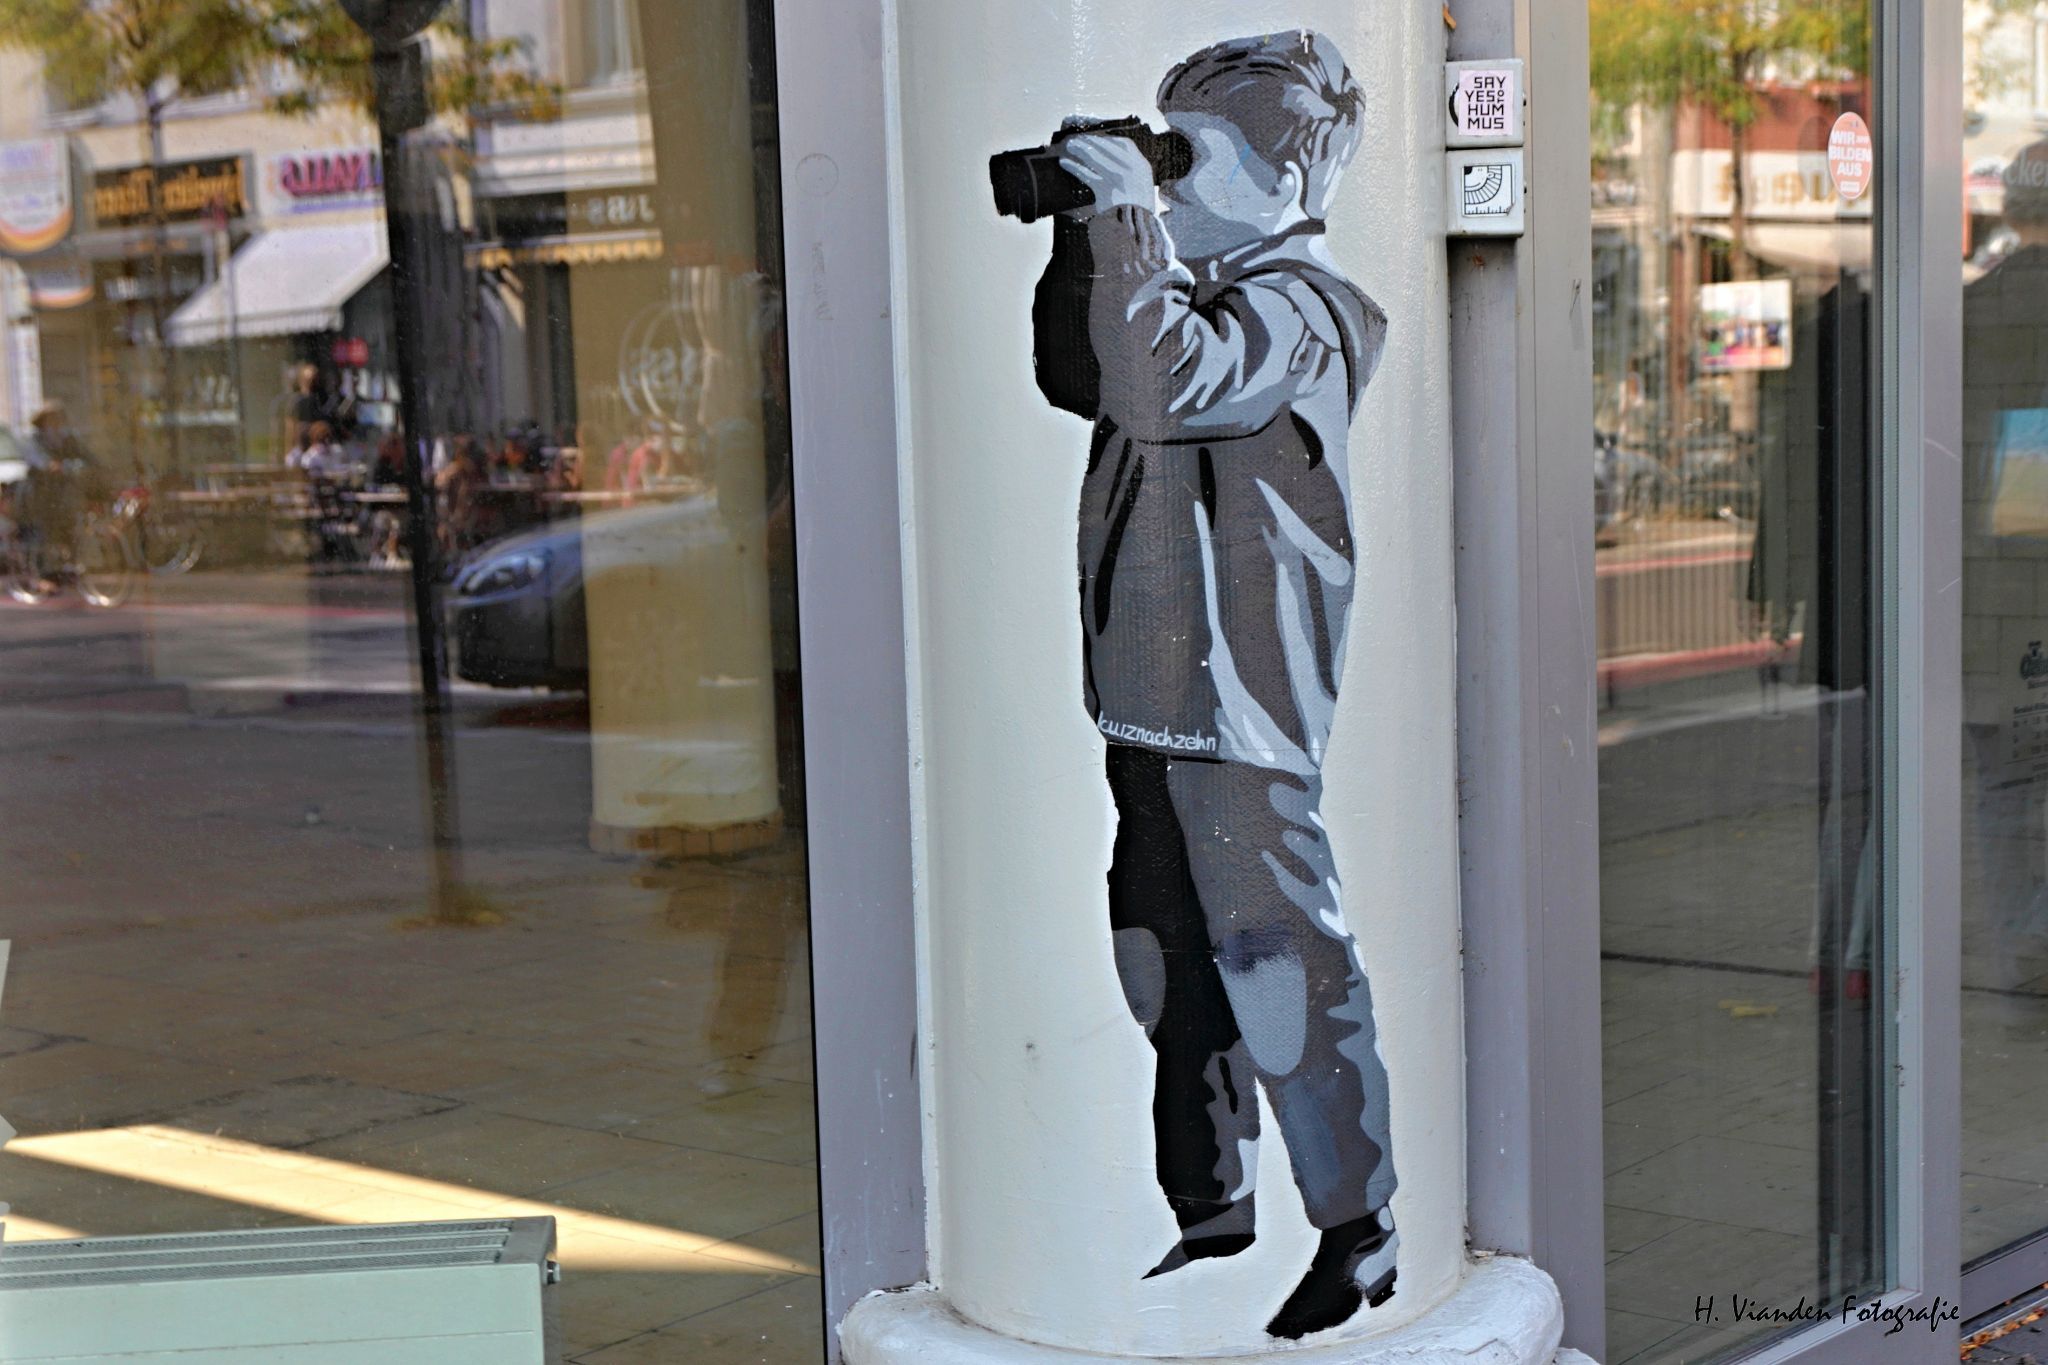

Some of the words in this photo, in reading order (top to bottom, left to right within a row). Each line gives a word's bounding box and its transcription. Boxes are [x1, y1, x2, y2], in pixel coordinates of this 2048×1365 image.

[1474, 76, 1506, 89] SAY
[1465, 90, 1495, 102] YES
[1467, 104, 1505, 116] HUM
[1467, 118, 1504, 130] MUS
[1831, 130, 1856, 144] WIR
[1829, 145, 1872, 161] BILDEN
[1837, 162, 1863, 177] AUS
[1098, 711, 1215, 750] kurznachzehn
